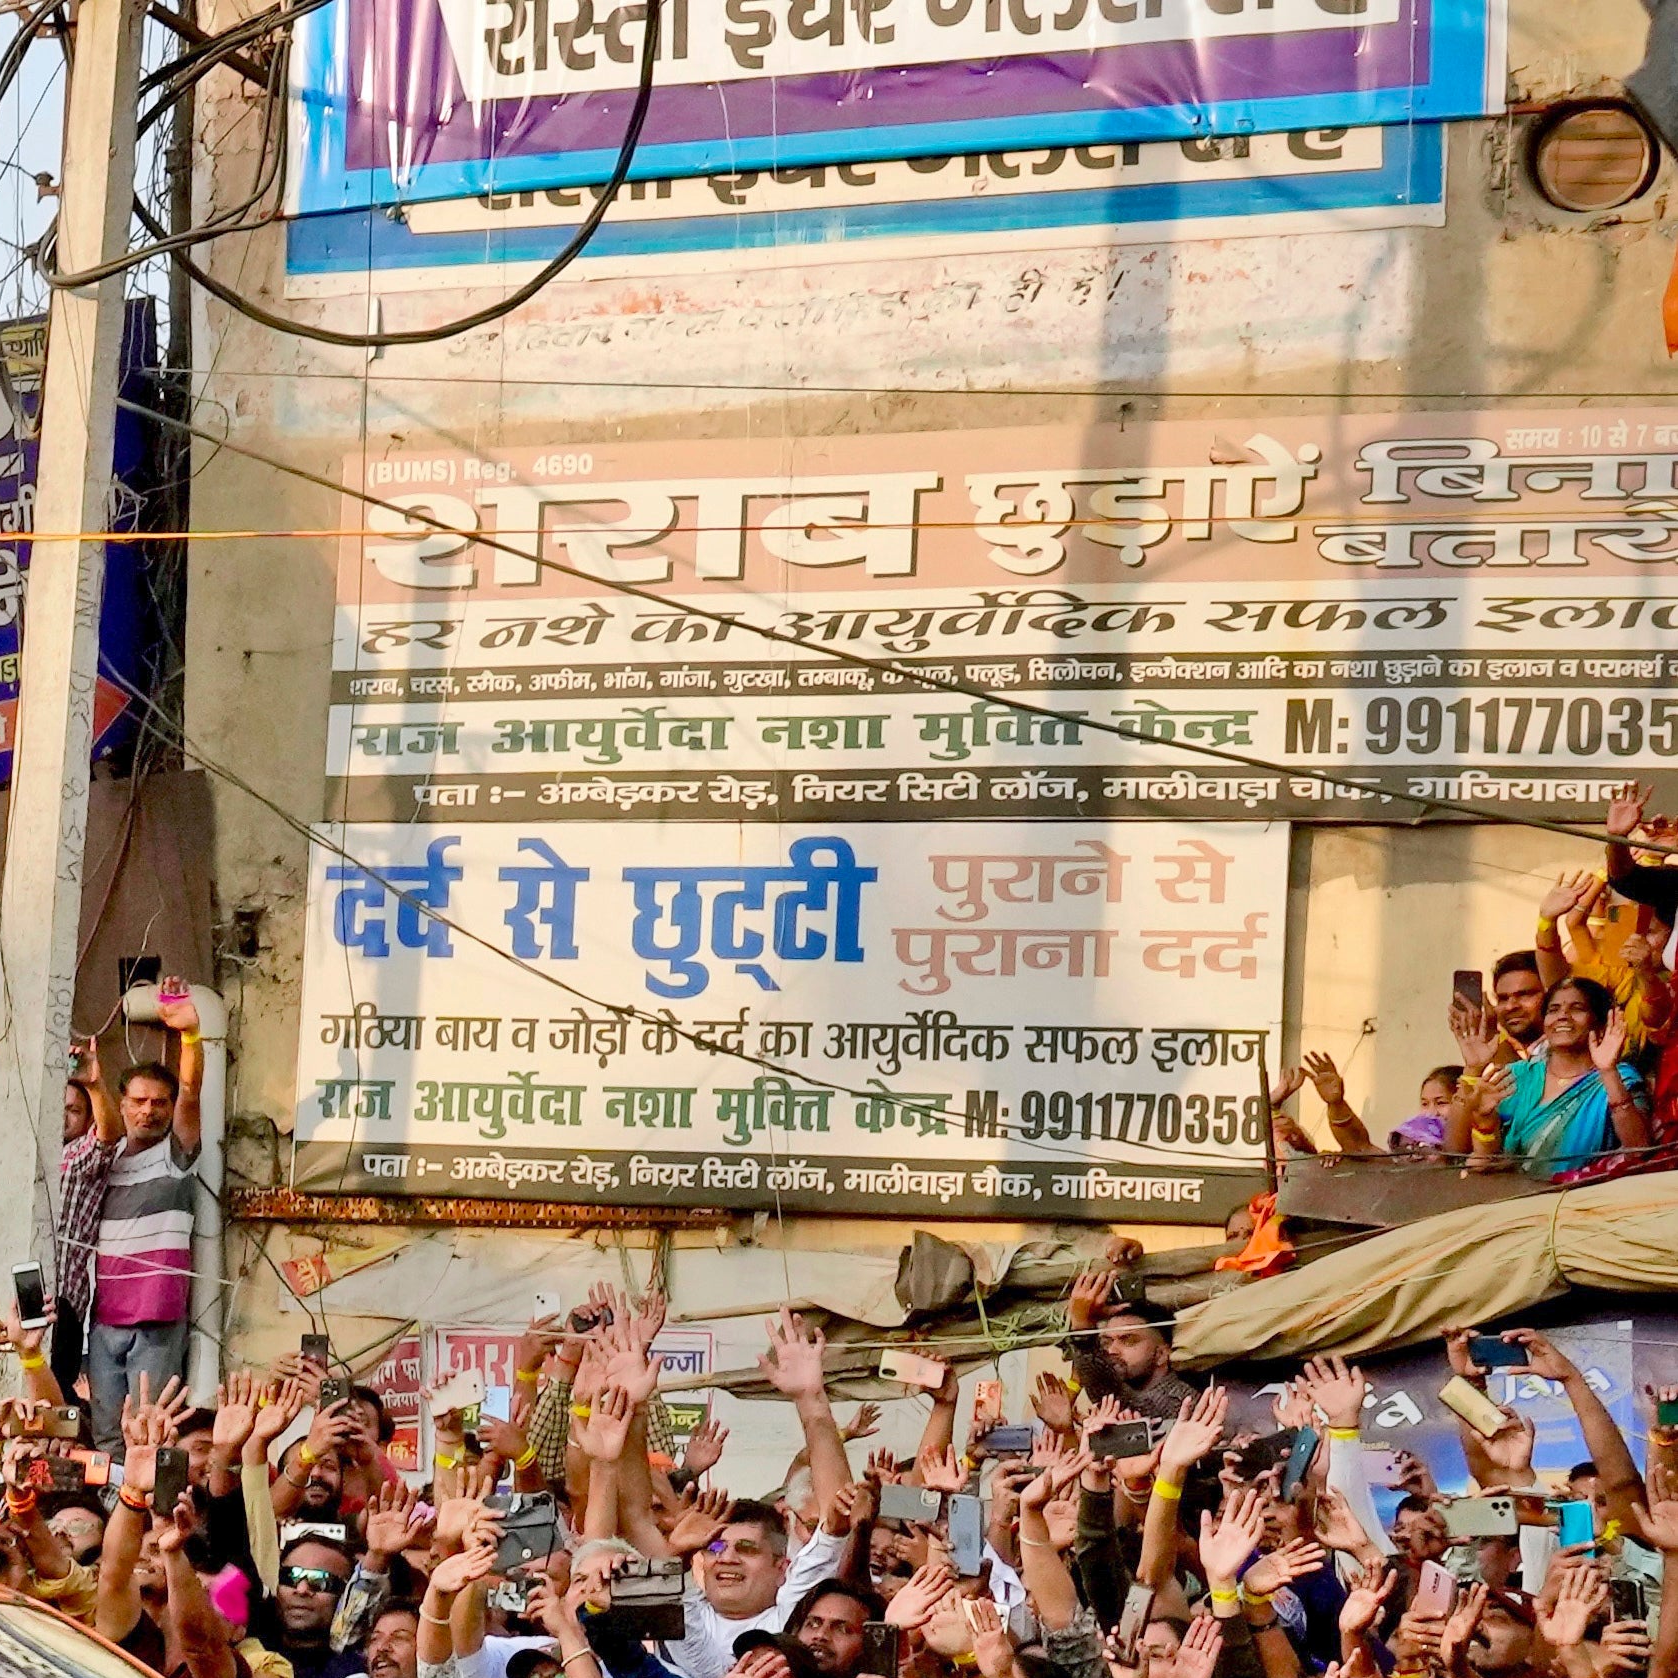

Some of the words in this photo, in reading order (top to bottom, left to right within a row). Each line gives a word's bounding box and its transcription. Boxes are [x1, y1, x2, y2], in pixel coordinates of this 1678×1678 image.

[1505, 427, 1561, 450] समय
[1580, 424, 1602, 448] 10
[1607, 418, 1629, 448] से
[1637, 424, 1648, 447] 7
[367, 459, 457, 487] (BUMS)
[464, 457, 517, 483] Reg.
[532, 454, 593, 477] 4690
[365, 471, 943, 592] शराब
[360, 619, 465, 655] हर
[478, 602, 616, 651] नशे
[630, 610, 746, 645] का
[763, 588, 1186, 654] आयुर्वेदिक
[1203, 599, 1458, 635] सफल
[349, 677, 405, 699] शराब,
[409, 675, 461, 697] चरस,
[466, 672, 522, 696] स्मैक,
[528, 668, 598, 694] अफीम,
[603, 665, 651, 692] भांग,
[659, 664, 717, 691] गांजा,
[723, 668, 792, 694] गुटखा,
[797, 665, 876, 692] तम्बाकू,
[1028, 657, 1123, 683] सिलोचन,
[1236, 654, 1289, 680] आदि
[1293, 657, 1329, 680] का
[1331, 659, 1378, 680] नशा
[1383, 653, 1443, 685] छुड़ाने
[1448, 657, 1482, 680] का
[1486, 657, 1553, 681] इलाज
[1558, 658, 1581, 679] व
[1584, 652, 1664, 680] परामर्श
[352, 719, 465, 757] राज
[491, 705, 735, 767] आयुर्वेदा
[755, 713, 892, 752] नशा
[913, 701, 1089, 762] मुक्ति
[1110, 699, 1259, 749] केन्द्र
[1284, 698, 1351, 756] M:
[413, 782, 481, 808] पता
[536, 776, 701, 811] अम्बेड़कर
[707, 775, 779, 811] रोड़,
[791, 771, 891, 803] नियर
[896, 771, 981, 802] सिटी
[989, 769, 1089, 803] लॉज,
[1102, 769, 1280, 810] मालीवाड़ा
[928, 840, 1131, 923] पुराने
[1153, 840, 1235, 904] से
[325, 836, 463, 958] दर्द
[498, 837, 591, 961] से
[621, 836, 879, 1000] छुट्टी
[891, 927, 1119, 996] पुराना
[1140, 911, 1270, 979] दर्द
[320, 1001, 426, 1051] गठिया
[436, 1016, 502, 1053] बाय
[511, 1018, 540, 1054] व
[548, 1006, 631, 1069] जोड़ों
[641, 1007, 684, 1058] के
[693, 1006, 752, 1058] दर्द
[760, 1020, 813, 1060] का
[823, 1010, 1014, 1076] आयुर्वेदिक
[1024, 1025, 1143, 1066] सफल
[1151, 1028, 1270, 1073] इलाज
[315, 1079, 396, 1121] राज
[414, 1071, 588, 1139] आयुर्वेदा
[602, 1085, 699, 1129] नशा
[712, 1076, 834, 1147] मुक्ति
[850, 1078, 954, 1137] केन्द्र
[964, 1089, 1010, 1139] M:
[1019, 1092, 1268, 1146] 9911770358
[362, 1152, 412, 1179] पता
[449, 1152, 565, 1190] अम्बेड़कर
[569, 1153, 620, 1194] रोड़,
[628, 1153, 697, 1188] नियर
[701, 1157, 761, 1190] सिटी
[765, 1158, 836, 1195] लॉज,
[843, 1162, 966, 1205] मालीवाड़ा
[970, 1164, 1043, 1202] चौक,
[1051, 1167, 1205, 1202] गाजियाबाद
